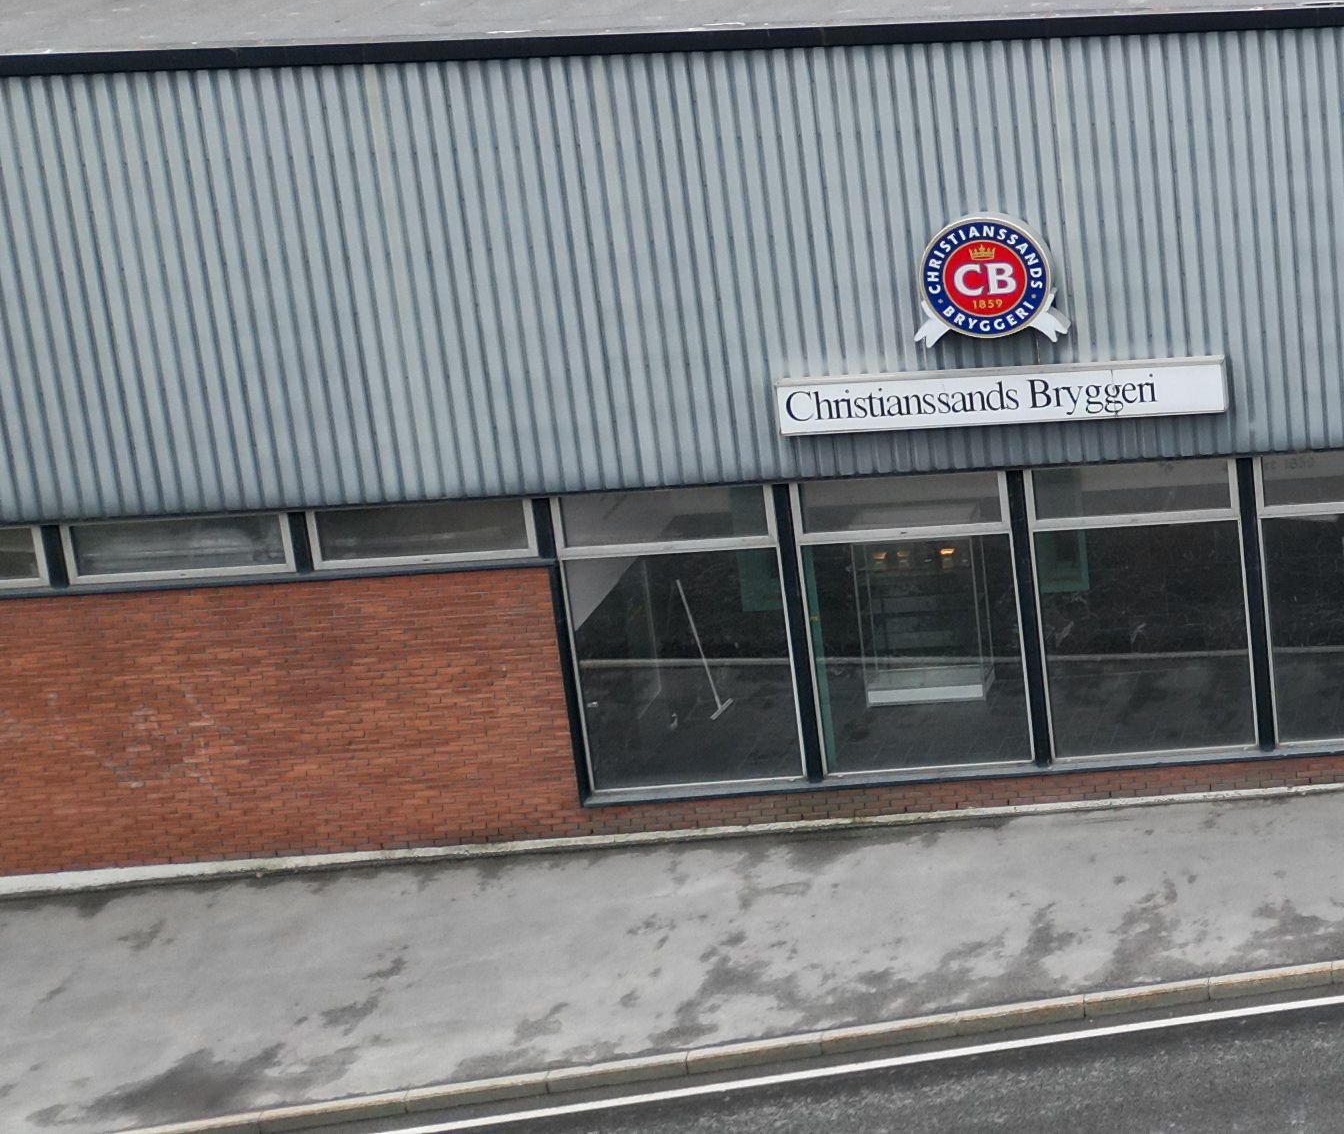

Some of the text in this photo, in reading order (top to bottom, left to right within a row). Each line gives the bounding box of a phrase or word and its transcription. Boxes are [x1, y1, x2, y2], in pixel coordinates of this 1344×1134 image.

[927, 226, 1043, 294] CHRISTIANSSANDS
[954, 262, 1018, 297] CB
[943, 301, 1035, 332] BRYGGERI
[972, 299, 1003, 310] 1859
[785, 373, 1157, 422] Christianssands Bryggeri
